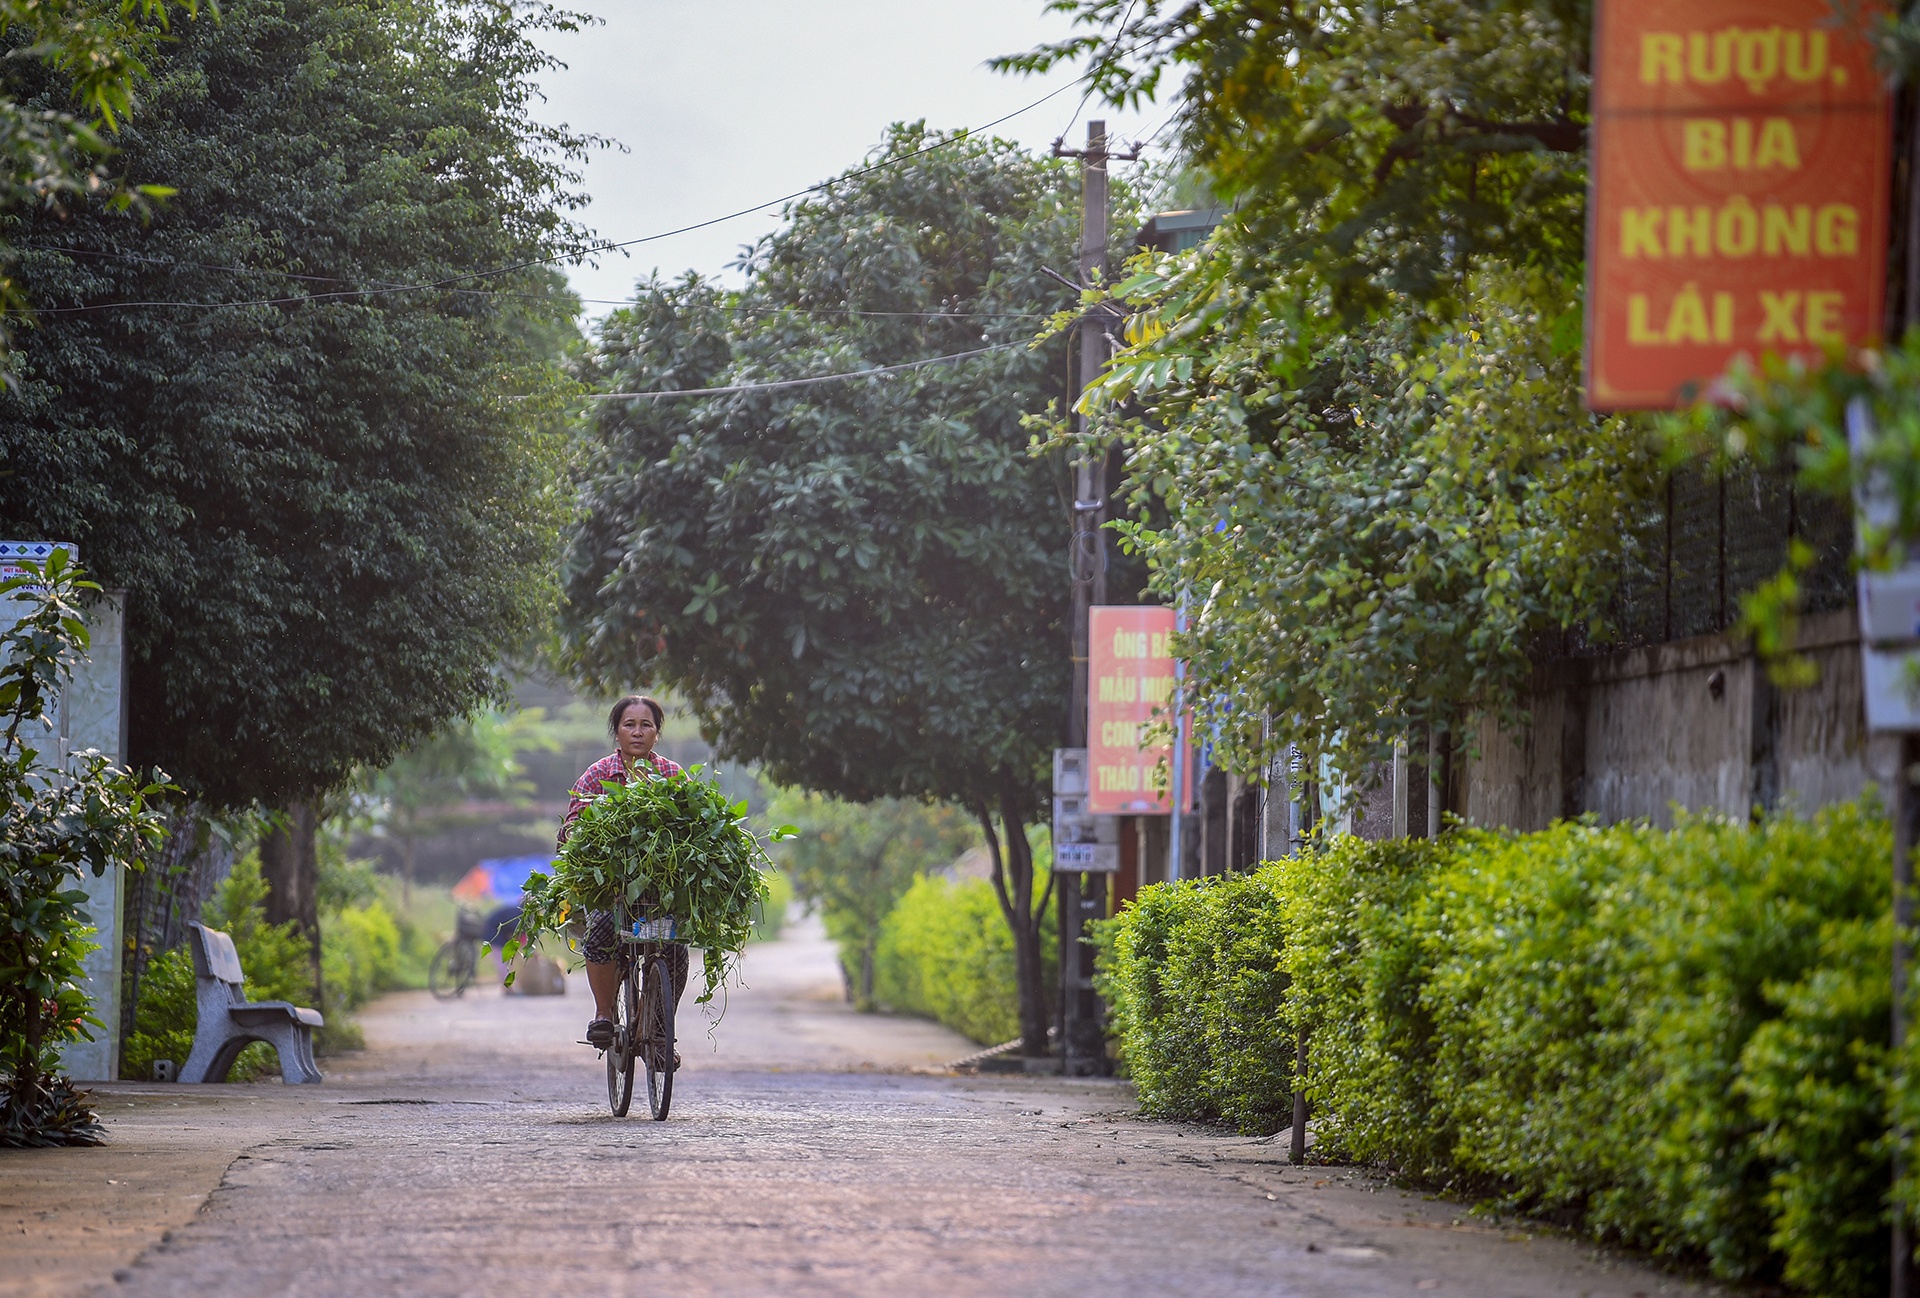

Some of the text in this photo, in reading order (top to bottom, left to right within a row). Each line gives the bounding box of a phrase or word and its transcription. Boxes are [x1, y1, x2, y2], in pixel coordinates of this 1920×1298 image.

[1639, 26, 1849, 95] RƯỢU,
[1683, 117, 1800, 171] BIA
[1620, 194, 1859, 259] KHÔNG
[1627, 281, 1846, 345] LÁI XE
[1113, 626, 1147, 659] ÔNG
[1102, 720, 1136, 748] CON
